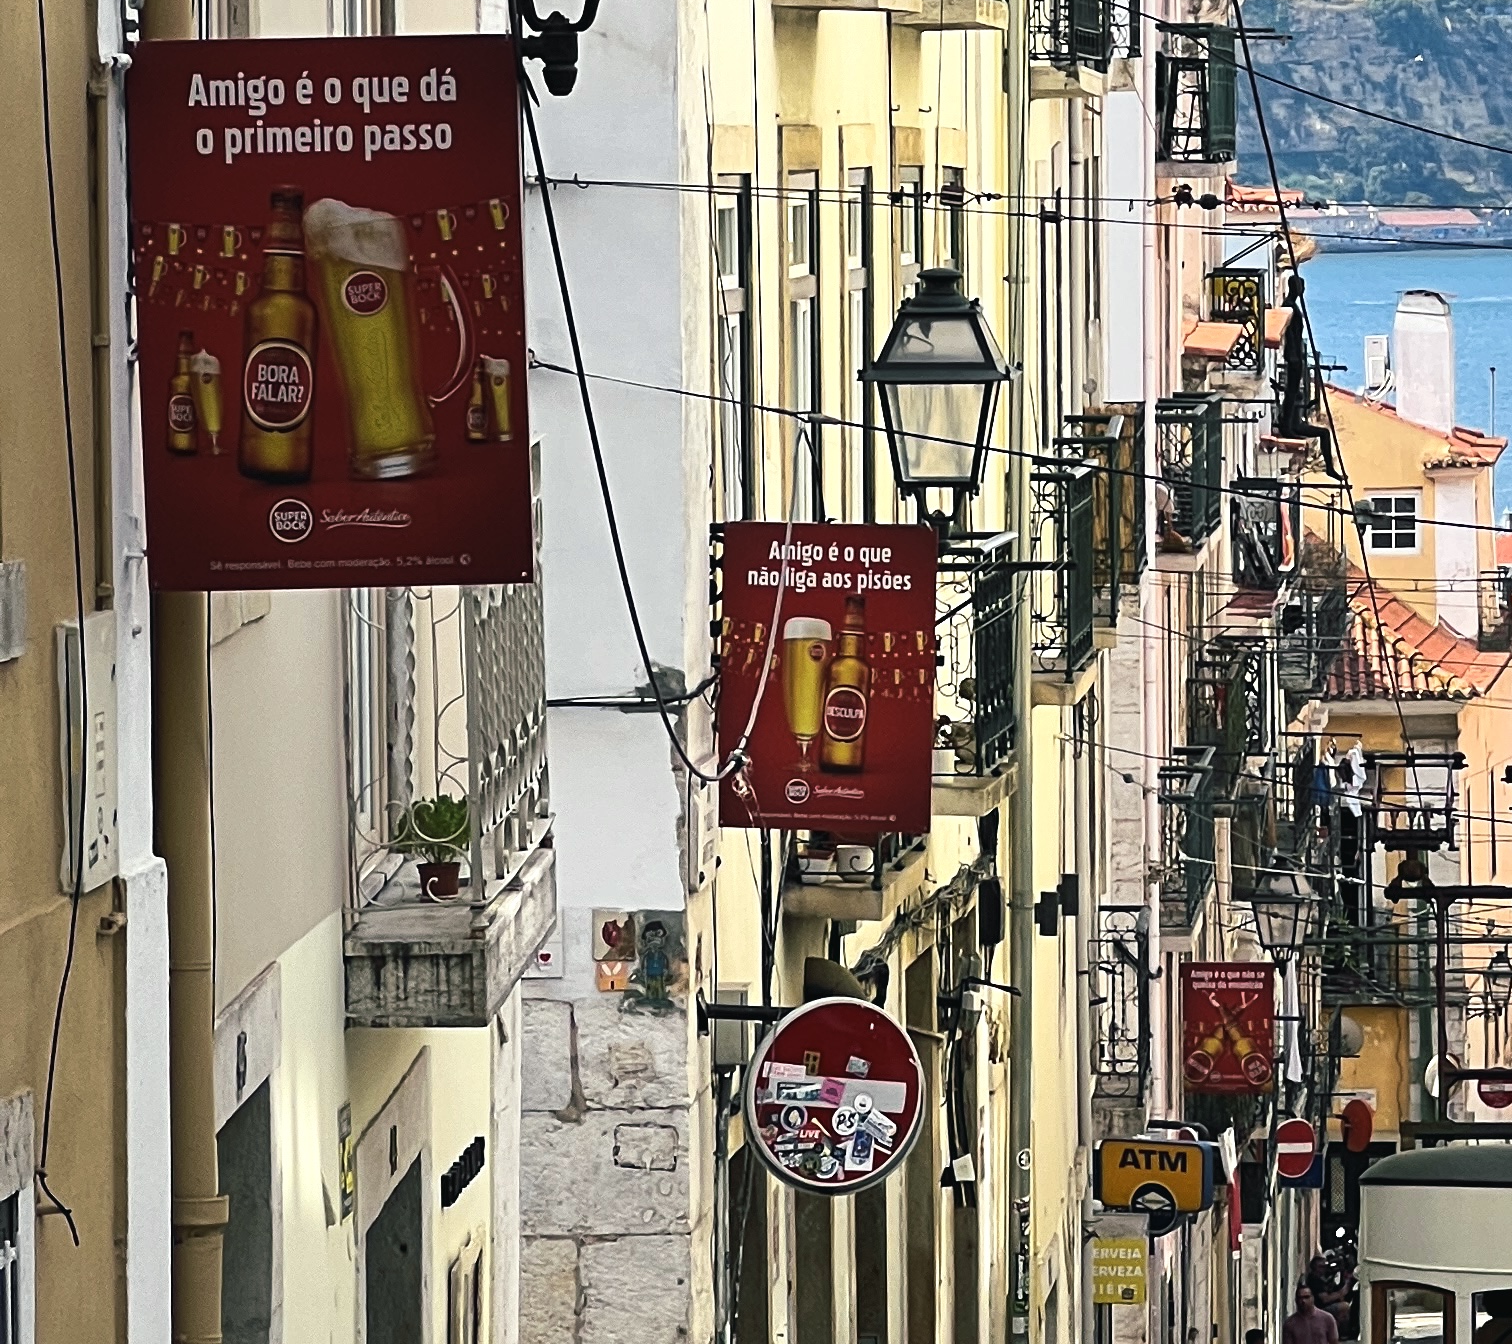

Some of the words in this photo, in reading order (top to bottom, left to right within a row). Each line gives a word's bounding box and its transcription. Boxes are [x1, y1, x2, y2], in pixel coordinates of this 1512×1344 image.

[188, 72, 285, 116] Amigo
[296, 71, 313, 104] é
[324, 77, 342, 104] o
[352, 76, 409, 113] que
[420, 67, 457, 102] dá
[196, 129, 213, 154] o
[224, 119, 353, 164] primeiro
[364, 123, 452, 161] passo
[348, 282, 382, 296] SUPER
[351, 292, 381, 304] BOCK
[258, 364, 299, 383] BORA
[251, 383, 304, 403] FALAR?
[274, 511, 307, 521] SUPER
[276, 521, 306, 531] BOCK
[769, 541, 823, 566] Amigo
[829, 542, 839, 561] é
[844, 547, 854, 562] o
[860, 547, 891, 568] que
[748, 567, 780, 586] não
[785, 566, 817, 592] liga
[822, 572, 852, 588] aos
[857, 570, 912, 594] pisões
[799, 1129, 820, 1139] LIVE
[1119, 1148, 1187, 1173] ATM
[1093, 1266, 1144, 1277] ERVEZA
